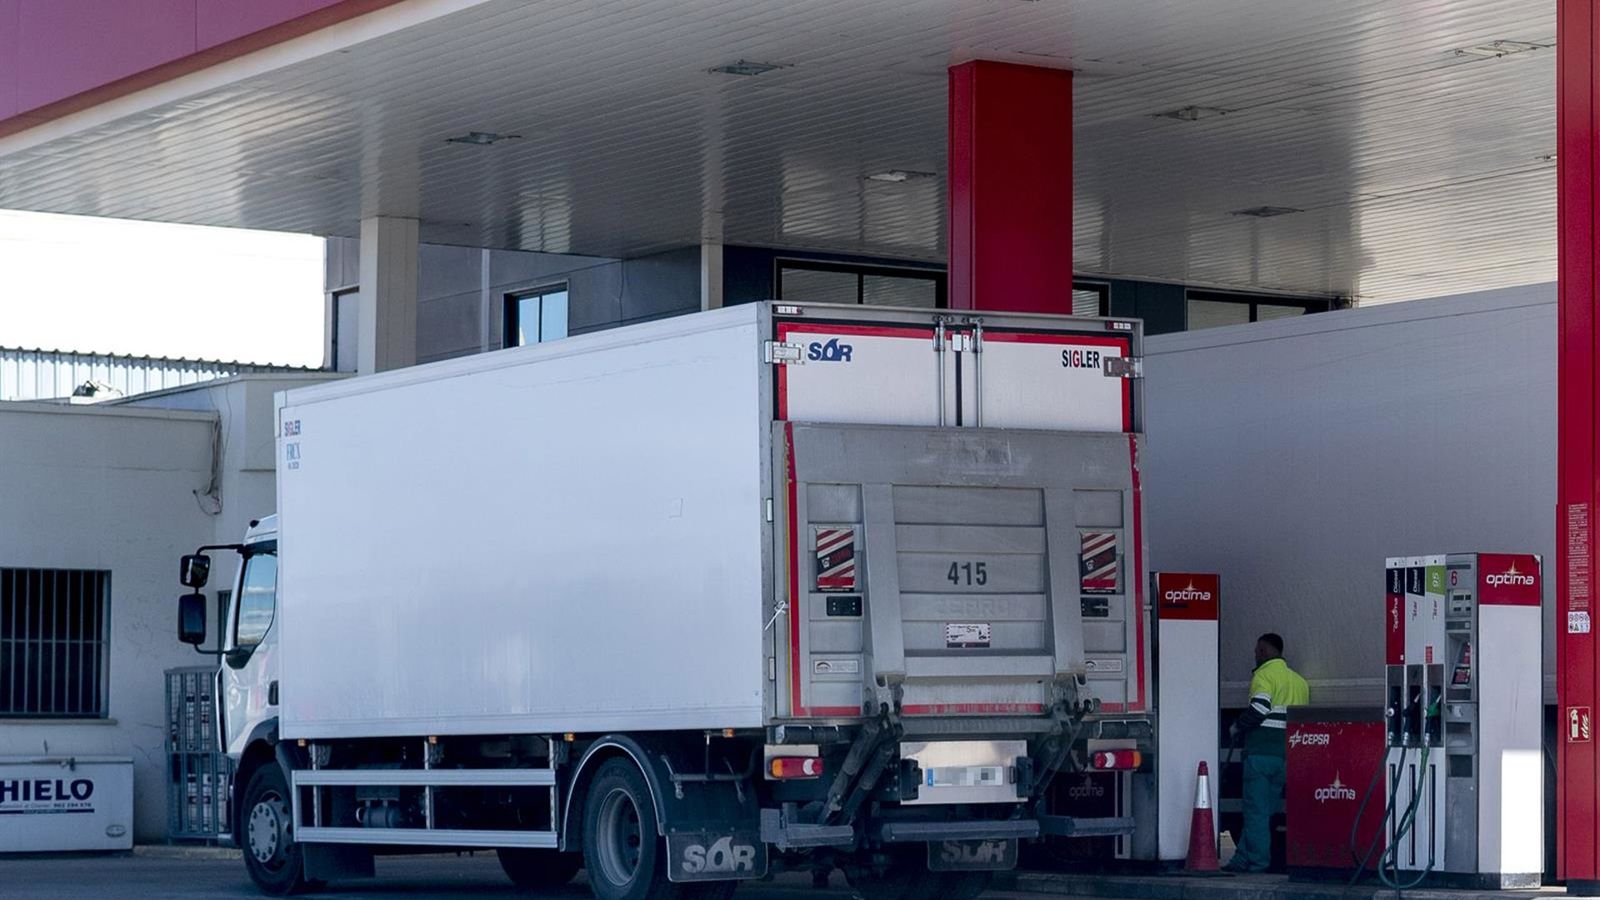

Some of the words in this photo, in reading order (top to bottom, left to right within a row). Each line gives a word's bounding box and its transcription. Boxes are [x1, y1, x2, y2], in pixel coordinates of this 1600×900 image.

[1062, 349, 1100, 369] SIGLER
[947, 561, 987, 586] 415
[1451, 570, 1458, 586] 6
[1486, 574, 1534, 587] optima
[1165, 590, 1211, 604] optima
[1302, 733, 1330, 745] CEPSA
[0, 779, 94, 801] HIELO
[1068, 784, 1105, 799] optima
[1314, 787, 1356, 804] optima
